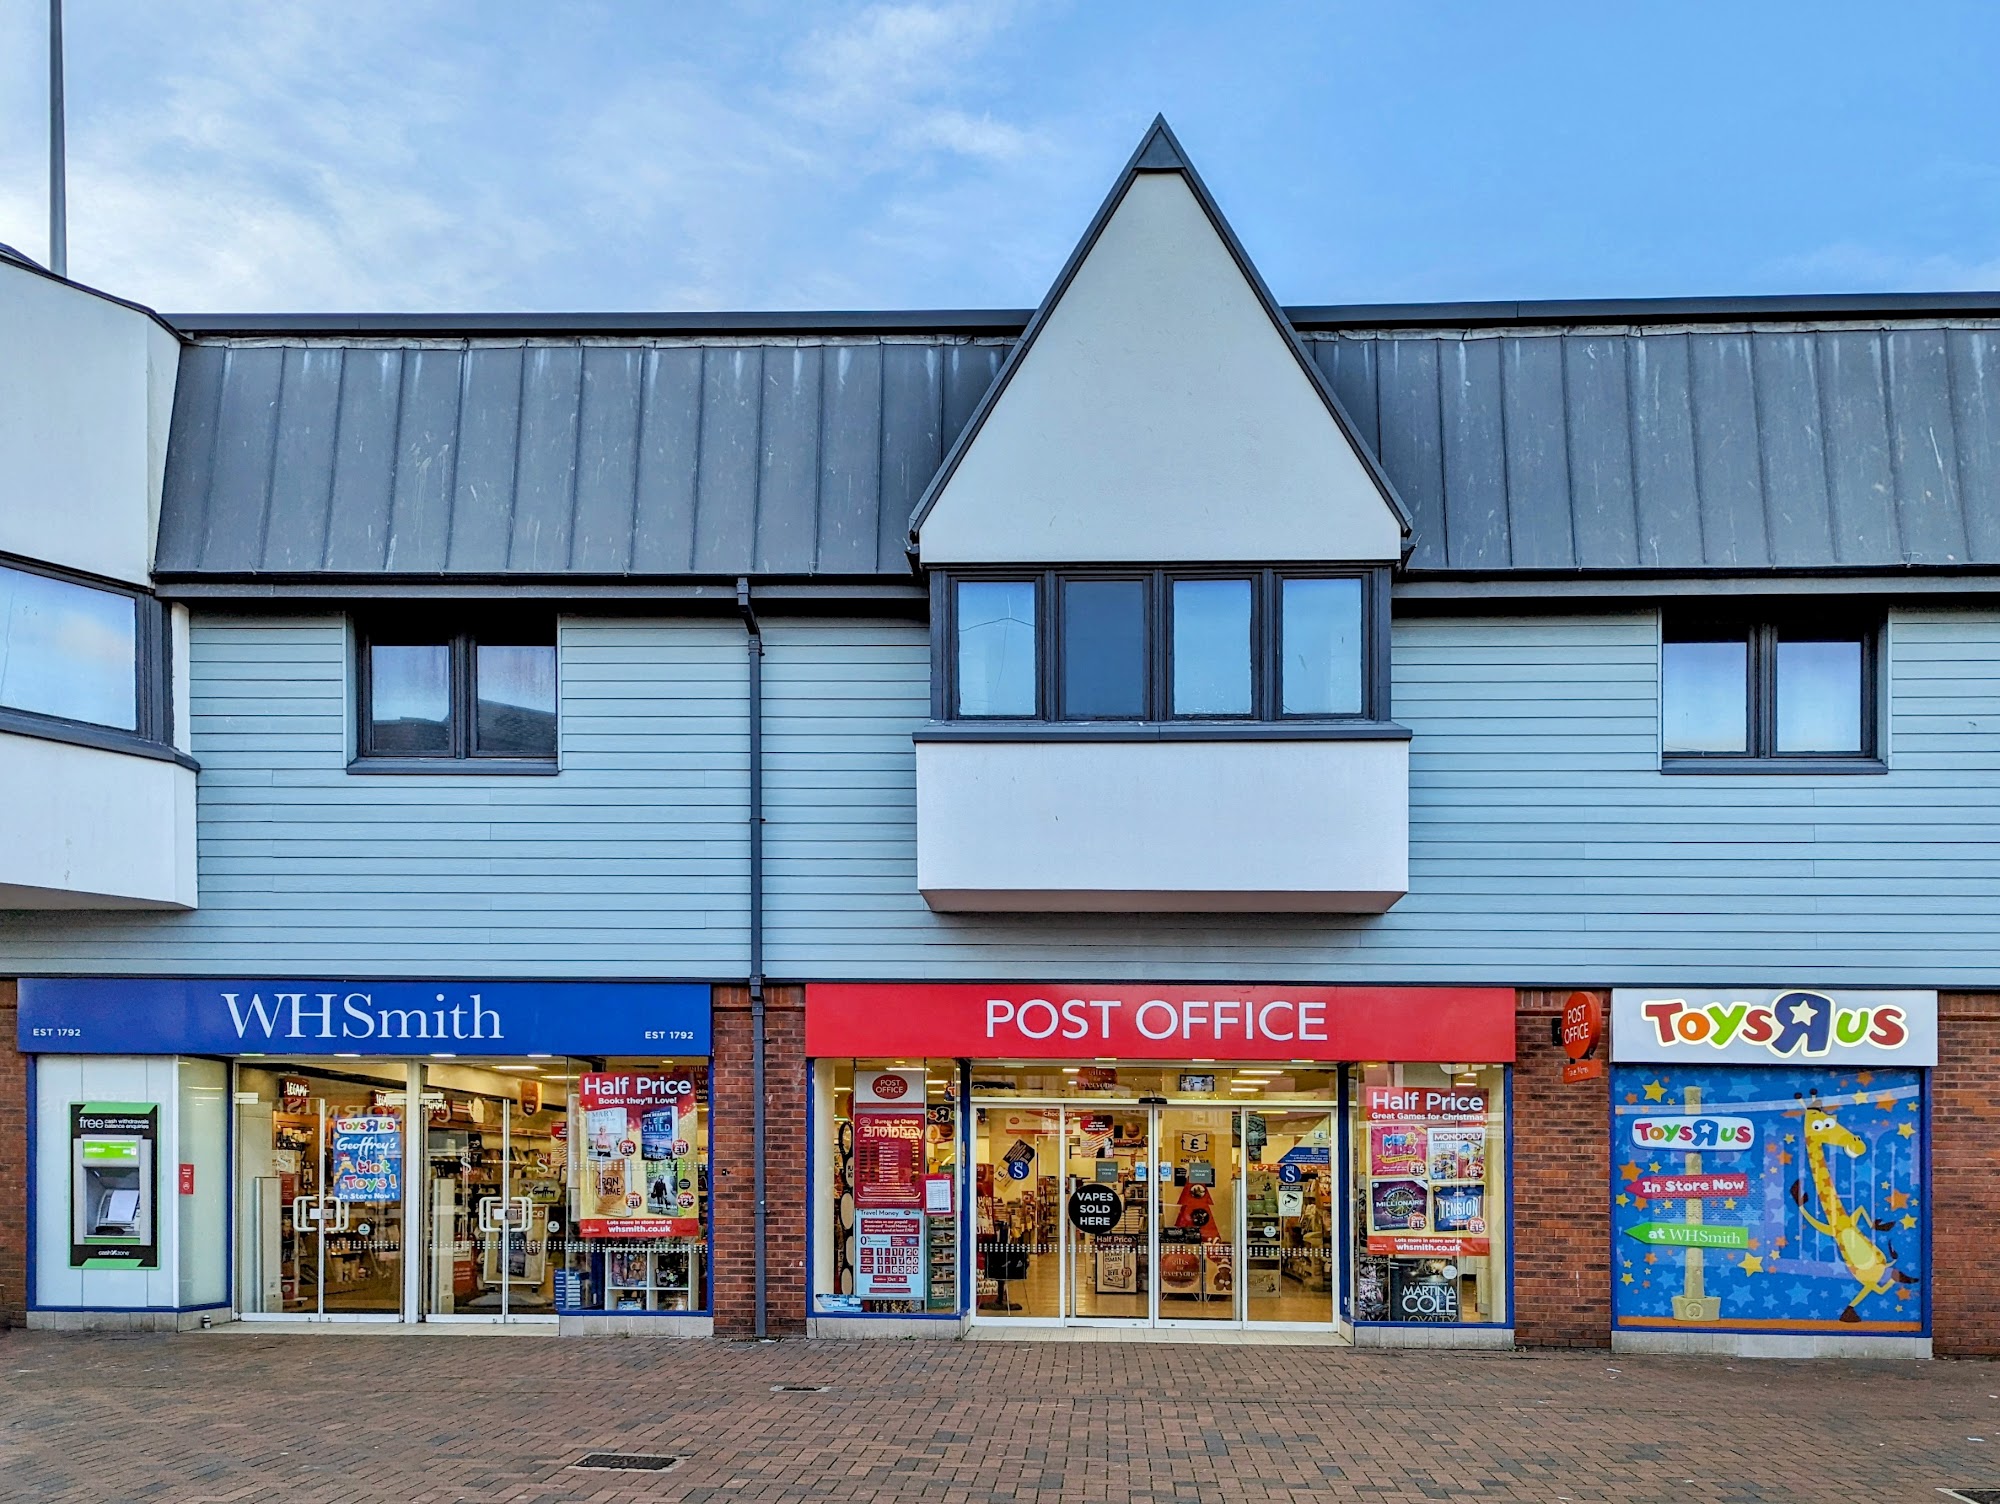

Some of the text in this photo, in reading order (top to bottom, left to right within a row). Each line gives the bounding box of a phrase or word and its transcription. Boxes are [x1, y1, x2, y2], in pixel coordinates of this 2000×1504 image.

[221, 993, 504, 1039] WHSmith
[986, 999, 1328, 1041] POST OFFICE
[1567, 1004, 1586, 1025] POST
[33, 1028, 81, 1037] EST 1792
[644, 1031, 694, 1039] EST 1792
[1564, 1022, 1589, 1044] OFFICE
[584, 1076, 691, 1095] Half Price
[598, 1097, 624, 1105] Books
[627, 1097, 652, 1105] they'll
[1372, 1091, 1484, 1111] Half Price
[648, 1117, 664, 1125] LEE
[1371, 1112, 1484, 1121] Great Games for Christmas
[79, 1116, 104, 1129] free
[642, 1123, 670, 1132] CHILD
[336, 1136, 396, 1158] Geoffrey's
[675, 1145, 687, 1153] £11
[357, 1159, 391, 1174] Hot
[1642, 1178, 1744, 1193] In Store Now
[1077, 1192, 1114, 1202] VAPES
[1079, 1204, 1111, 1214] SOLD
[1376, 1199, 1424, 1208] MILLIONAIRE
[1440, 1196, 1479, 1219] TENSION
[1079, 1216, 1111, 1226] HERE
[1113, 1235, 1133, 1243] Price
[1648, 1229, 1741, 1245] at WHSmith
[1396, 1243, 1461, 1251] whsmith.co.uk
[1402, 1285, 1456, 1296] MARTINA
[1402, 1295, 1456, 1313] COLE
